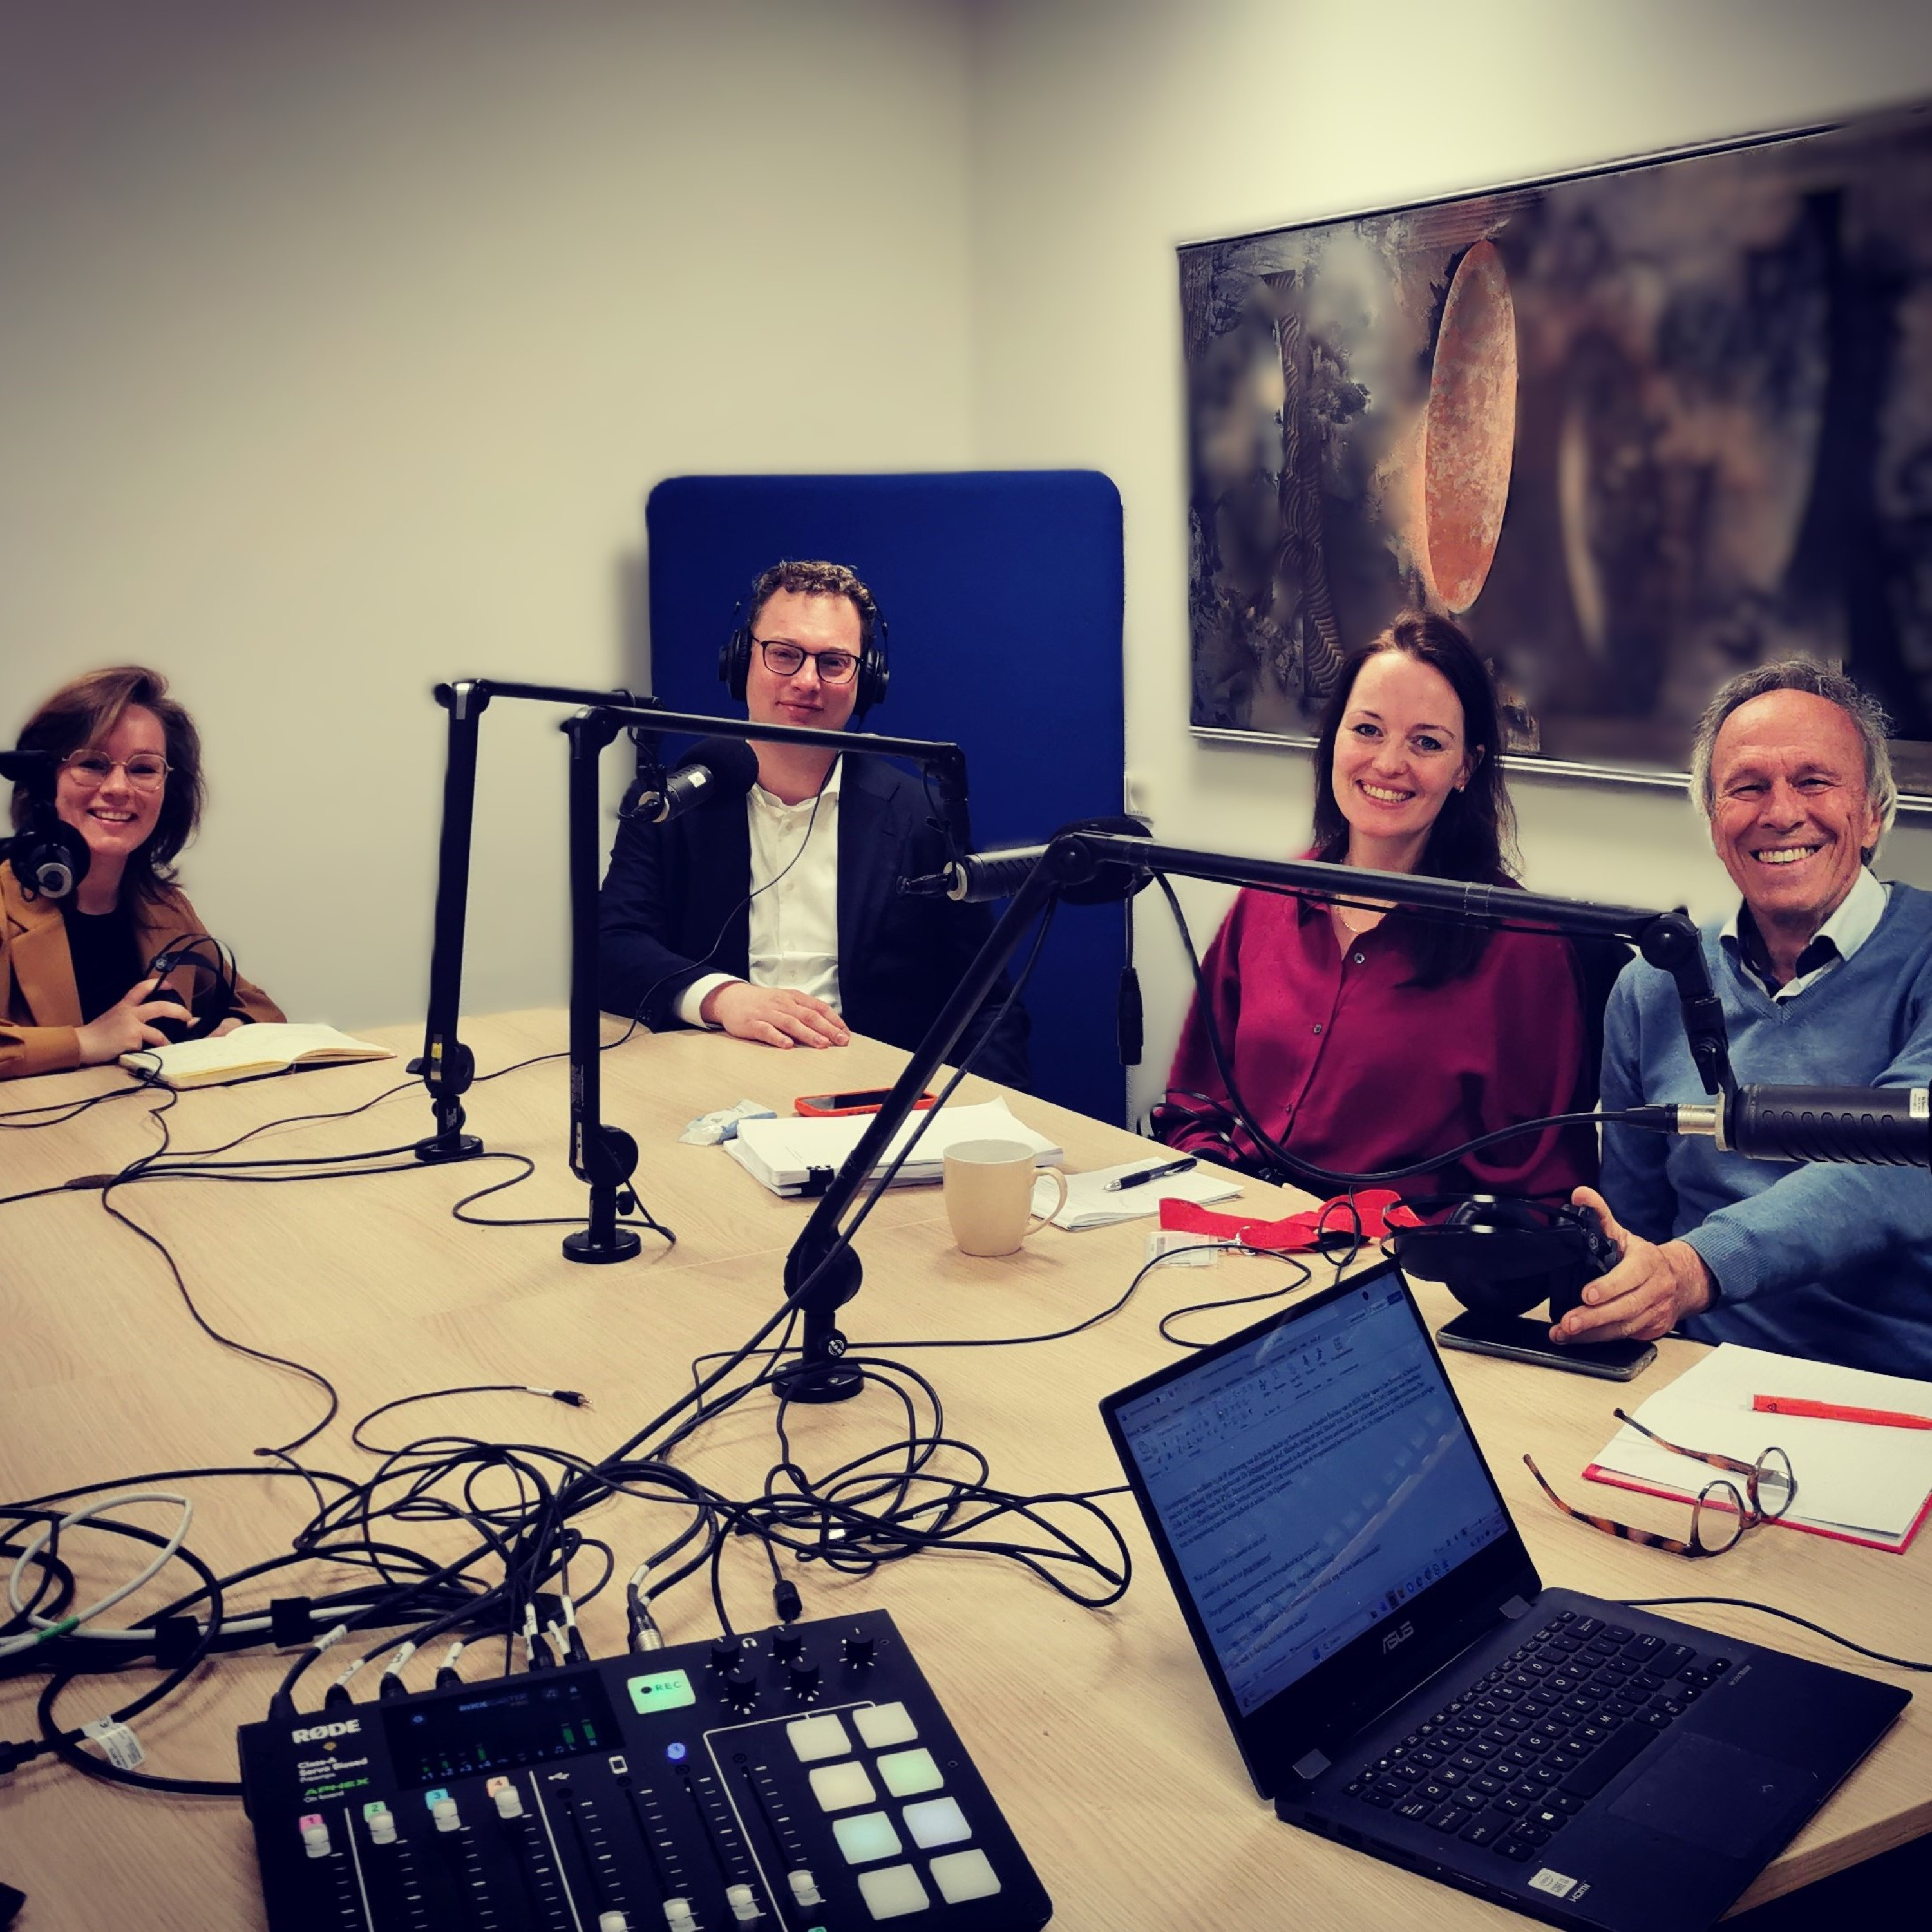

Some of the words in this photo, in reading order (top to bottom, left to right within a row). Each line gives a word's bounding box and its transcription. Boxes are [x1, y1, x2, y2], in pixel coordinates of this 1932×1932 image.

[1382, 1620, 1414, 1654] ASUS
[655, 1681, 682, 1691] REC
[292, 1718, 362, 1743] RØDE
[433, 1792, 441, 1800] 3
